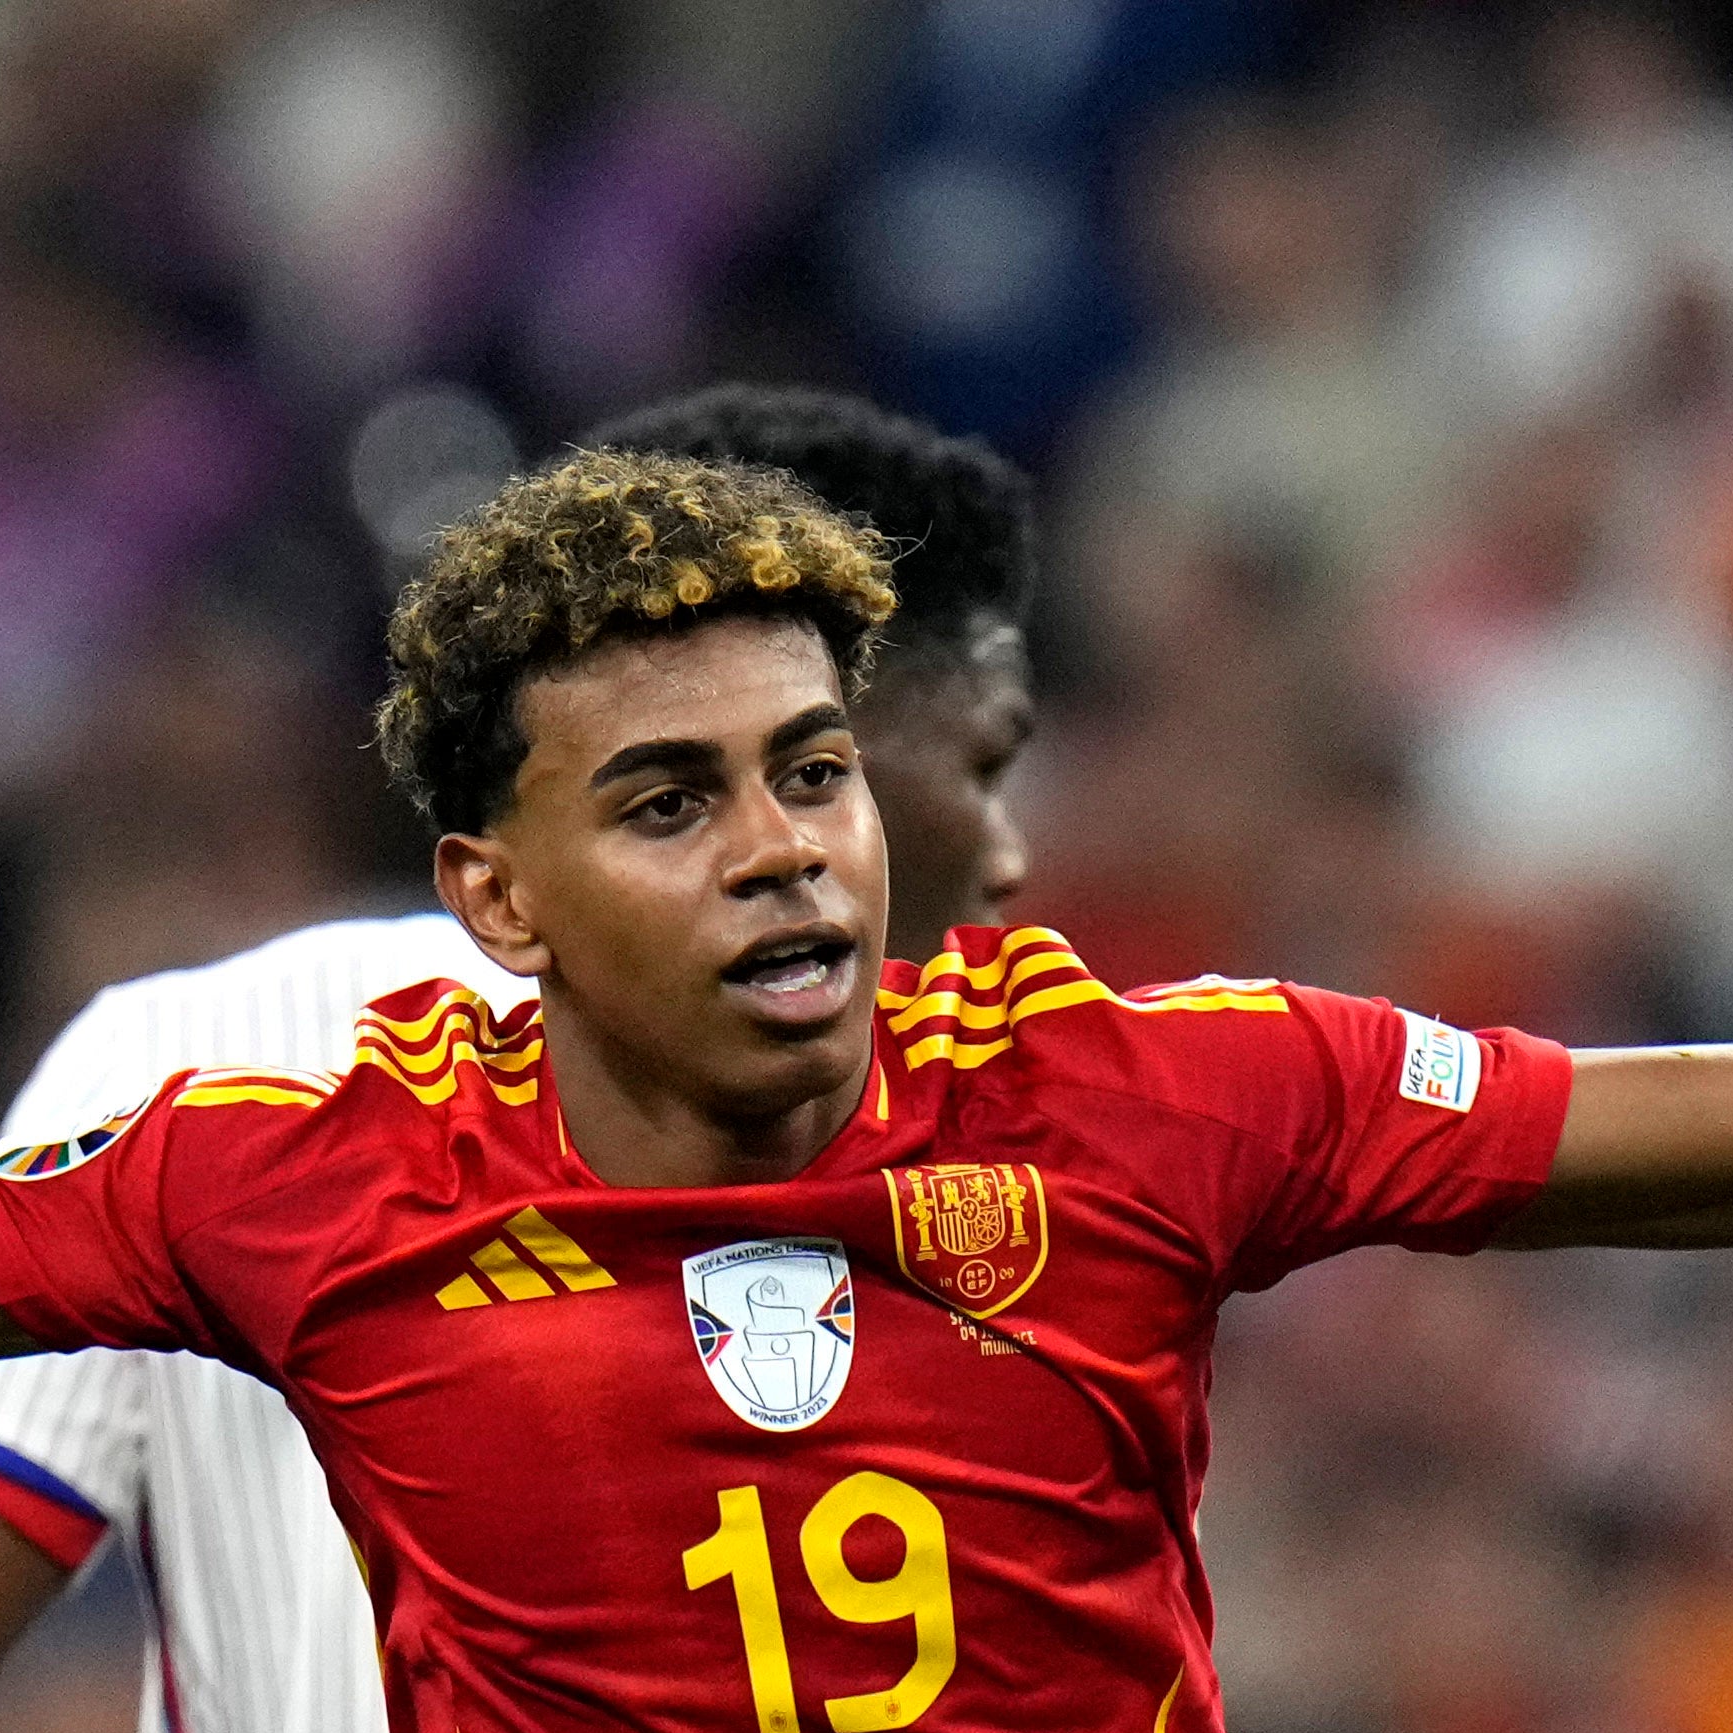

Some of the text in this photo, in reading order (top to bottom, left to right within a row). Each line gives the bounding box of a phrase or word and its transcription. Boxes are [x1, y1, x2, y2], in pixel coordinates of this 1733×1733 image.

[1406, 1048, 1426, 1095] UEFA
[691, 1256, 725, 1274] UEFA
[726, 1244, 783, 1262] NATIONS
[749, 1396, 828, 1425] WINNER 2023
